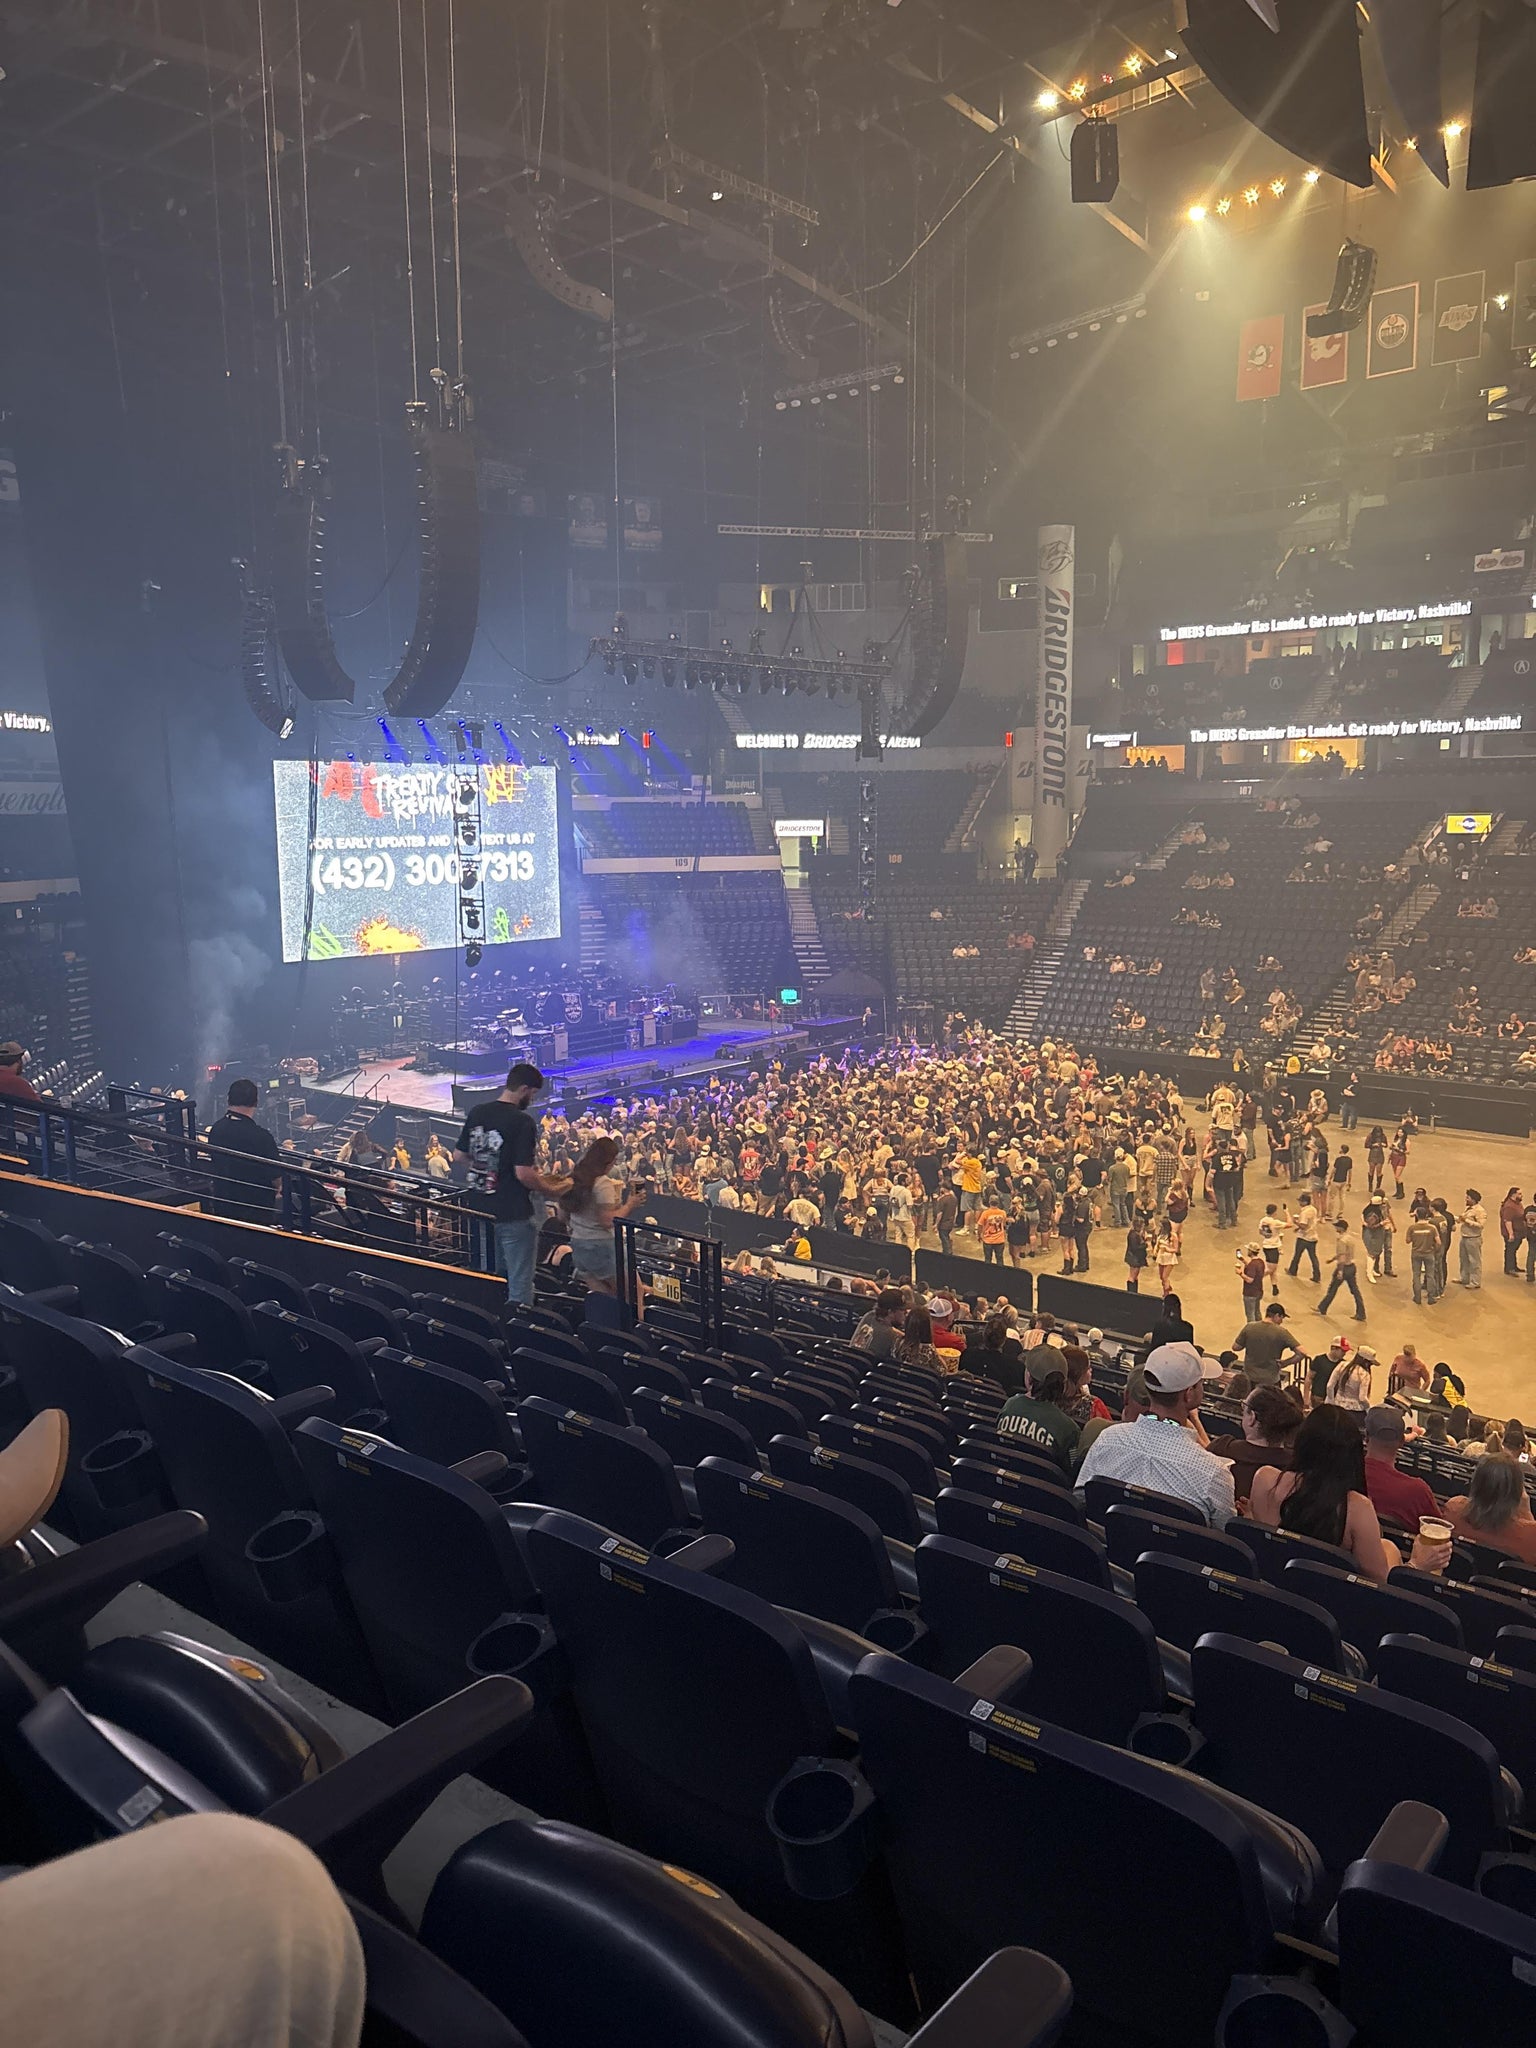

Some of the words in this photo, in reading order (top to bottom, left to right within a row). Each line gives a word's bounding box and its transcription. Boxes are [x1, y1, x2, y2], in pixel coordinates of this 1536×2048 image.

[1160, 628, 1177, 641] The
[1206, 622, 1250, 638] Grenadier
[1251, 620, 1270, 634] Has
[1270, 616, 1308, 632] Landed.
[1309, 615, 1327, 629] Get
[1328, 612, 1357, 628] ready
[1358, 610, 1375, 625] for
[1376, 607, 1417, 624] Victory,
[1418, 600, 1472, 619] Nashville!
[1043, 586, 1070, 808] BRIDGESTONE
[3, 712, 51, 732] Victory,
[1190, 729, 1208, 743] The
[1238, 726, 1286, 741] Grenadier
[1286, 724, 1306, 739] Has
[1307, 723, 1347, 738] Landed.
[1348, 722, 1367, 737] Get
[1369, 721, 1400, 737] ready
[1400, 719, 1418, 735] for
[1419, 718, 1463, 734] Victory,
[1464, 715, 1522, 732] Nashville!
[735, 733, 783, 749] WELCOME
[784, 734, 799, 748] TO
[803, 732, 887, 749] BRIDGESE
[887, 736, 921, 748] ARENA
[369, 771, 445, 807] TREATY
[1239, 786, 1252, 795] 107
[391, 795, 468, 821] REVIVAL
[310, 836, 334, 850] OR
[336, 836, 373, 850] EARLY
[375, 835, 426, 849] UPDATES
[428, 834, 451, 847] AND
[481, 832, 505, 846] TEXT
[506, 832, 521, 845] US
[522, 832, 535, 845] AT
[311, 852, 396, 895] (432)
[405, 850, 536, 886] 3007313
[675, 858, 689, 867] 109
[666, 1284, 680, 1300] 116
[998, 1415, 1054, 1446] OURAGE
